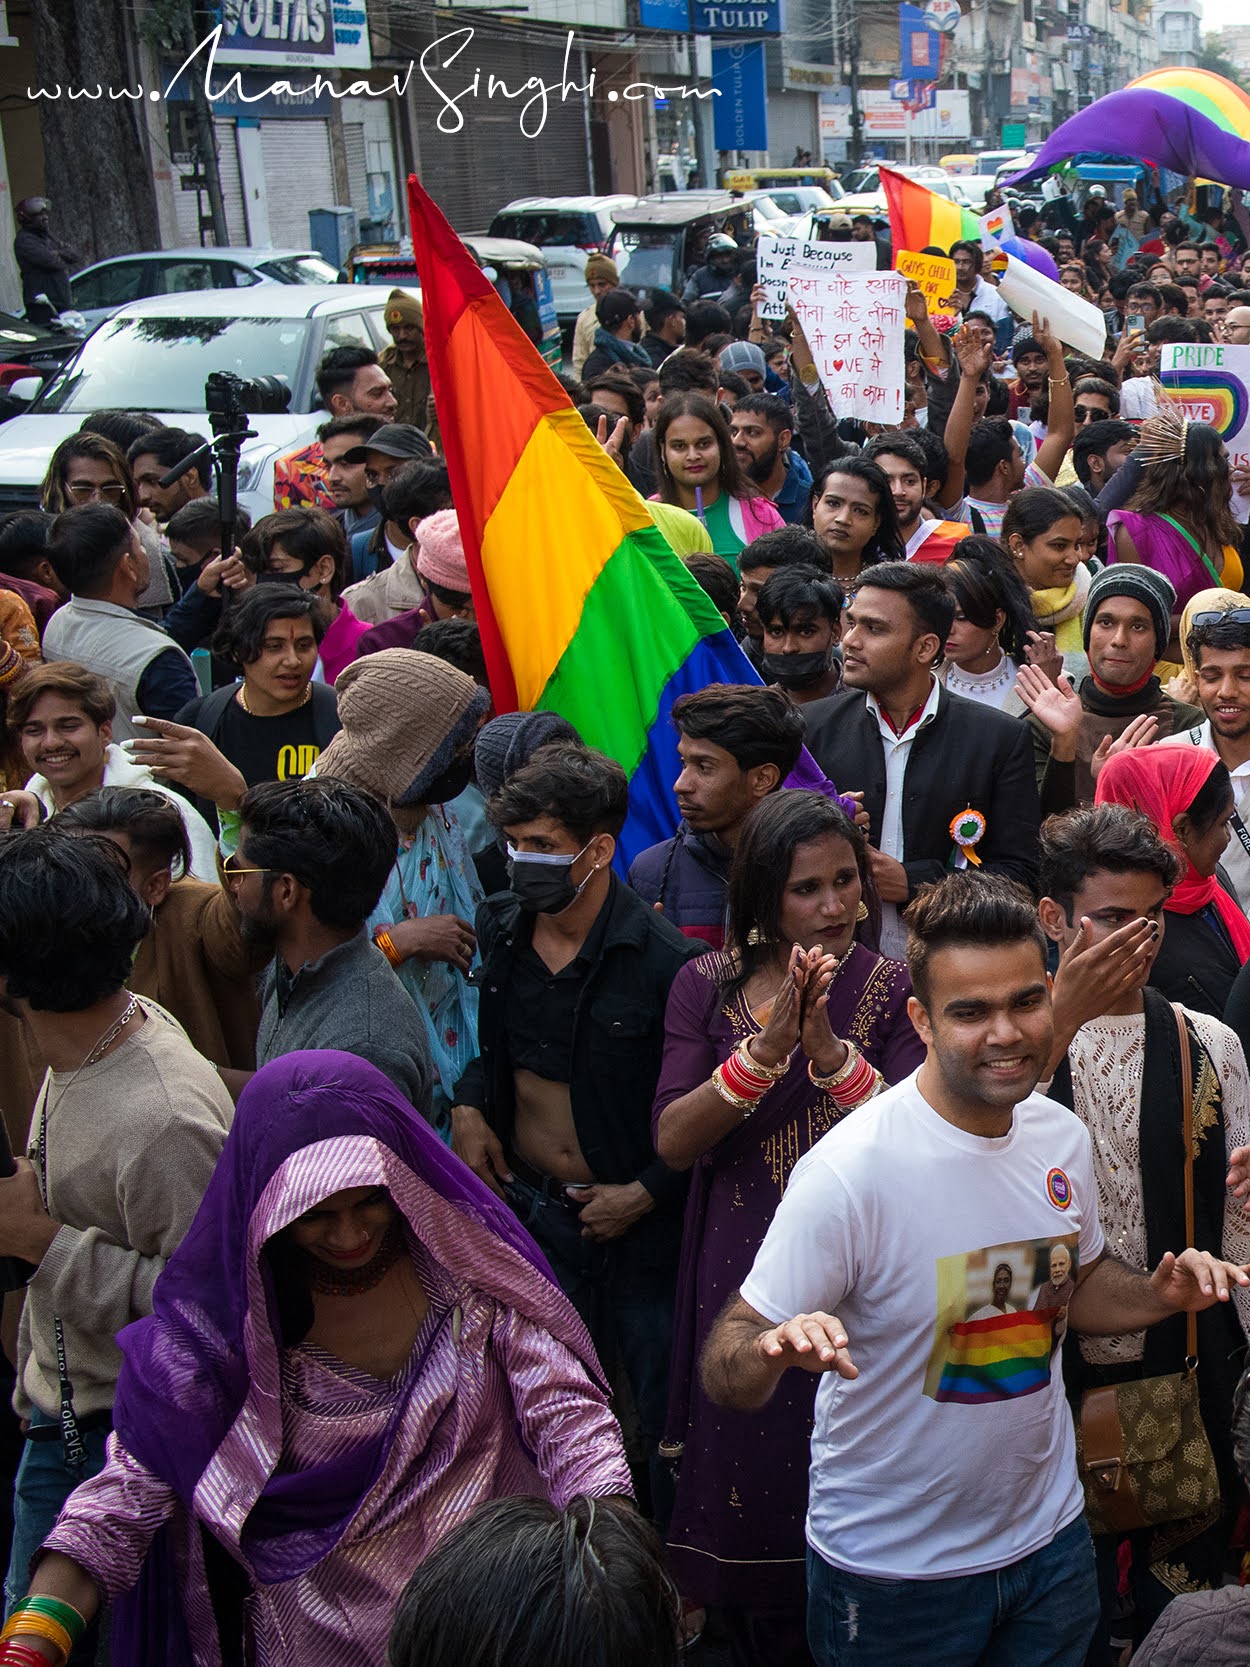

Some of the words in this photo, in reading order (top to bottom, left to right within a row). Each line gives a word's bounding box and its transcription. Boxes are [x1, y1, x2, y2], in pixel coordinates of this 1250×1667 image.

[933, 2, 951, 12] HP
[221, 0, 327, 43] VOLTAS
[703, 8, 769, 28] TULIP
[733, 62, 743, 95] TULIP
[735, 98, 745, 146] GOLDEN
[771, 242, 796, 257] Just
[802, 244, 853, 261] Because
[760, 274, 788, 287] Doesn
[902, 259, 925, 276] GUYS
[928, 264, 951, 281] CHILL
[789, 276, 821, 297] राम
[1171, 345, 1225, 369] PRIDE
[1233, 452, 1250, 467] IS
[61, 1399, 85, 1461] FOREVE
